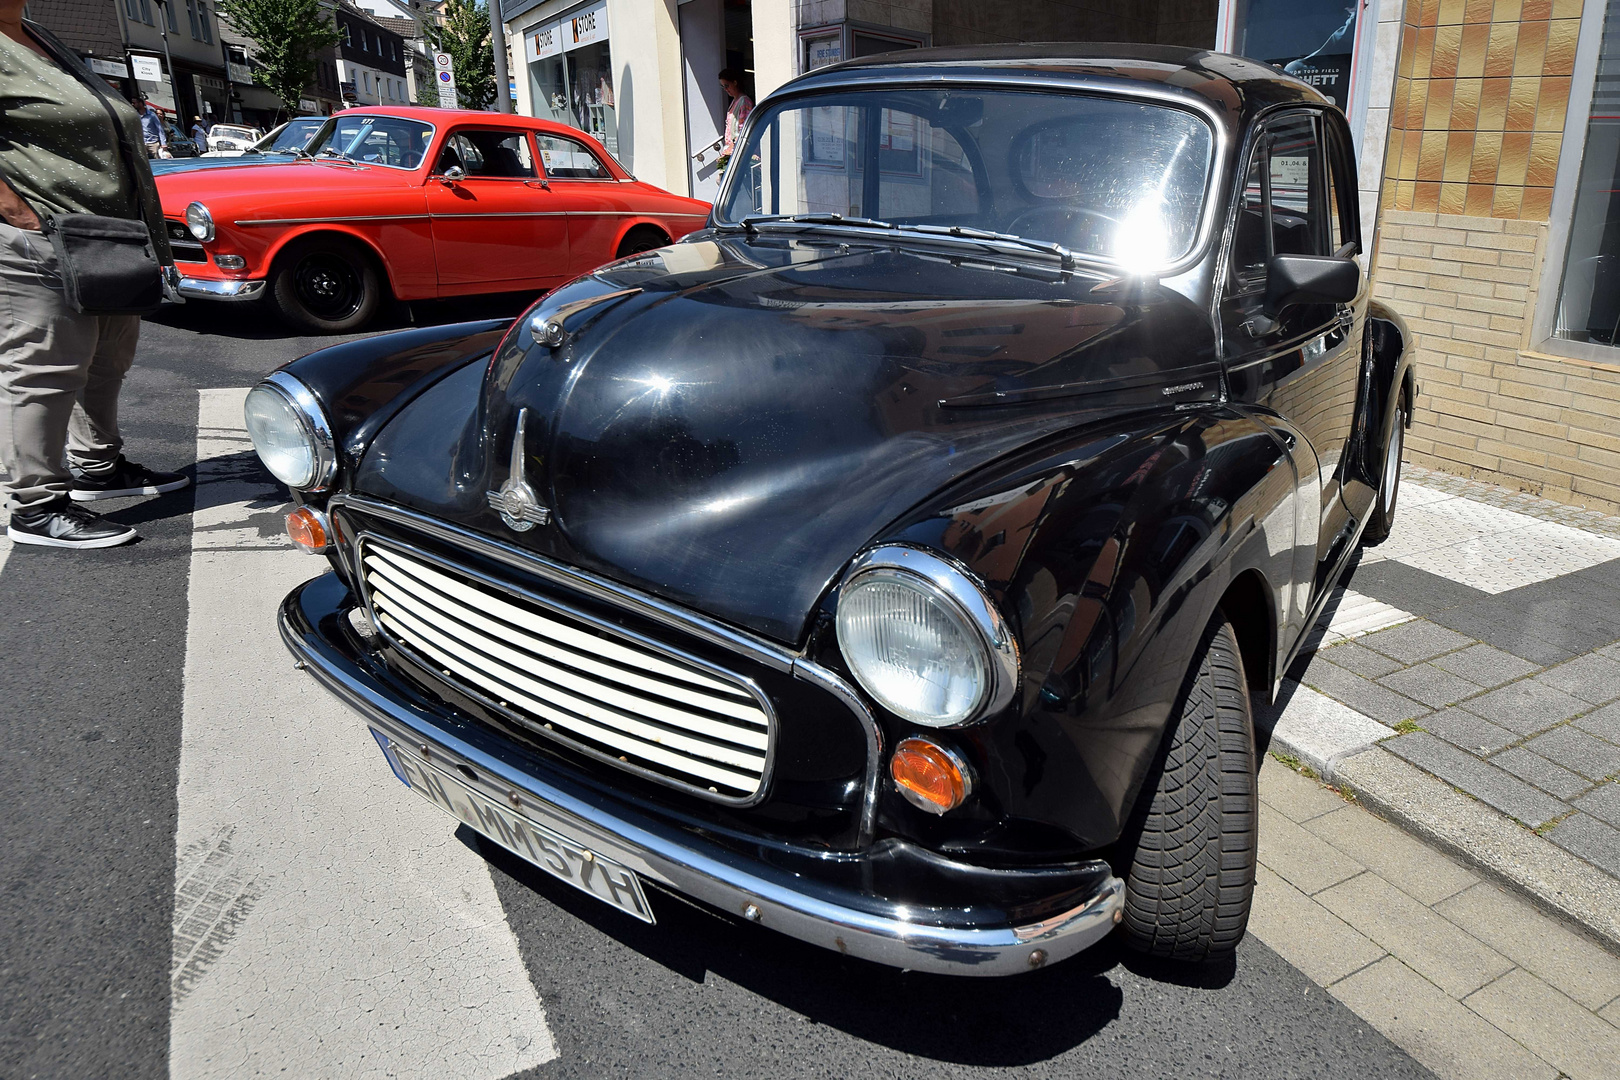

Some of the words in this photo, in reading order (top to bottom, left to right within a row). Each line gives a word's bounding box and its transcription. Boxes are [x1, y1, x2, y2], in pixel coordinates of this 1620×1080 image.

[578, 12, 596, 34] STORE
[539, 30, 553, 48] STORE
[395, 749, 455, 813] EN
